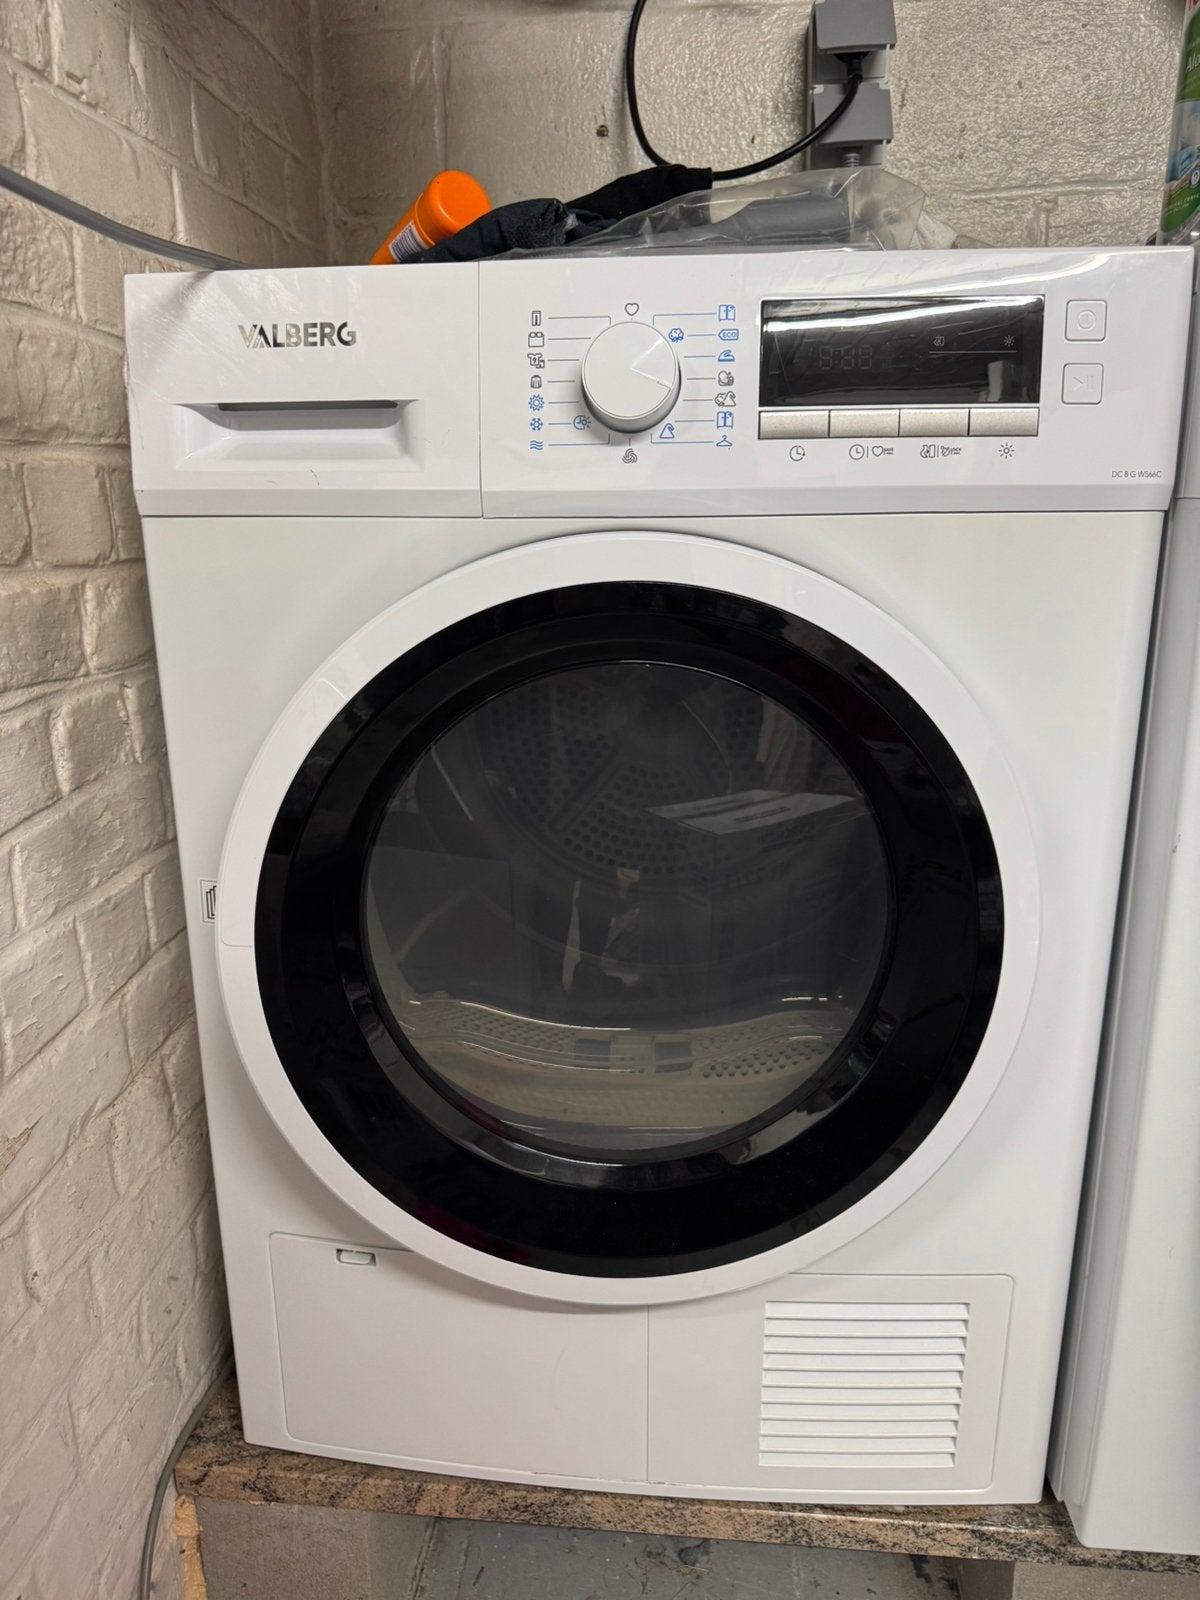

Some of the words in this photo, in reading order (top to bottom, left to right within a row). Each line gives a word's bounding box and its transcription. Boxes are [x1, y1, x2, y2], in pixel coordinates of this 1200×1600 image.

[238, 321, 357, 348] VALBERG
[722, 331, 737, 339] ECO
[1111, 470, 1123, 478] DC
[1124, 470, 1129, 478] 8
[1130, 470, 1137, 478] G
